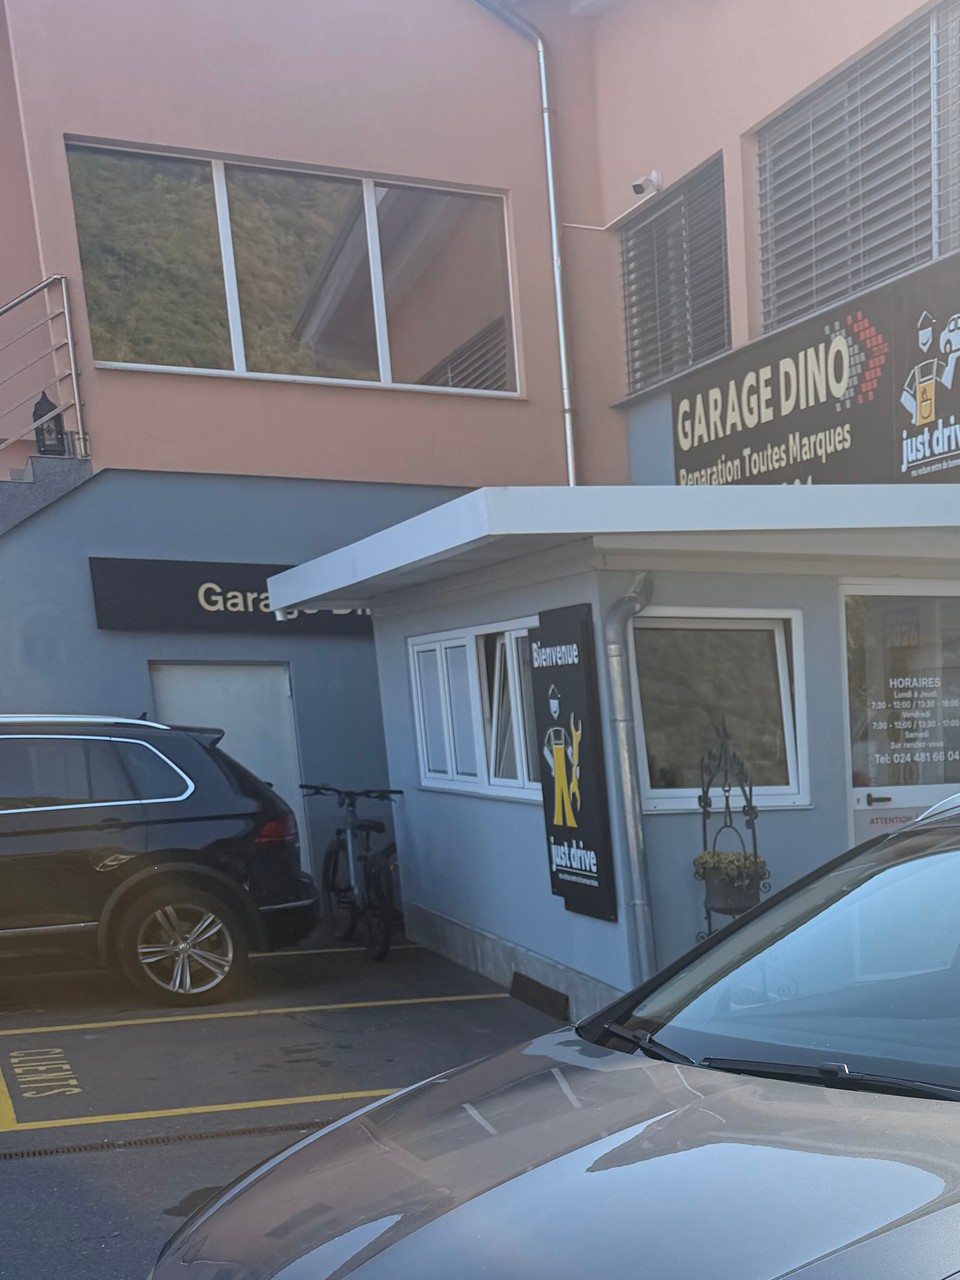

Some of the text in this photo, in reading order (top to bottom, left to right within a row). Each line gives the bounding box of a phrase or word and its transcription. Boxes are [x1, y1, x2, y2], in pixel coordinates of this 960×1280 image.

[677, 335, 850, 451] GARAGE DINO
[742, 443, 787, 478] Toutes
[788, 423, 852, 465] Marques
[901, 427, 931, 473] just
[531, 640, 579, 668] Bienvenue
[889, 677, 941, 689] HORAIRES
[893, 753, 911, 763] 024
[913, 752, 931, 763] 481
[932, 751, 945, 762] 66
[947, 751, 960, 761] 04
[870, 815, 914, 825] ATTENTION
[550, 835, 598, 873] just drive
[9, 1048, 82, 1098] CLIENTS
